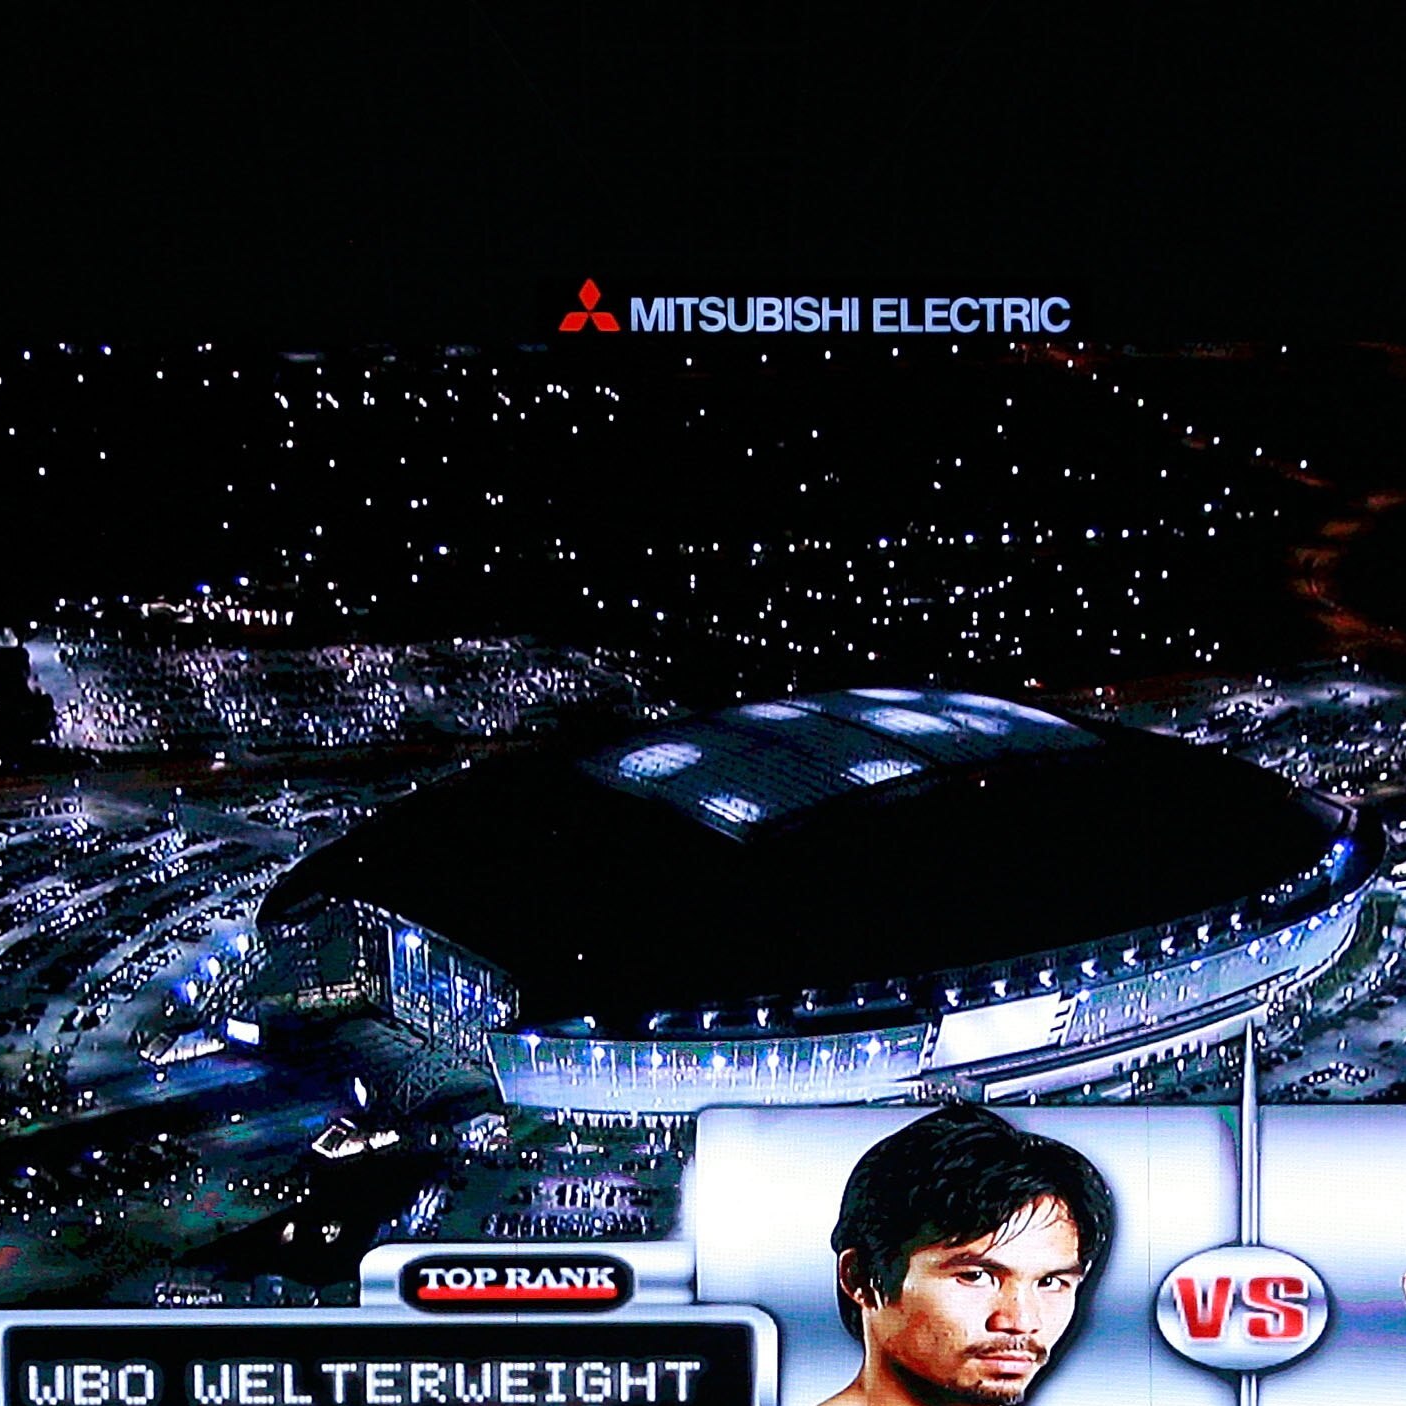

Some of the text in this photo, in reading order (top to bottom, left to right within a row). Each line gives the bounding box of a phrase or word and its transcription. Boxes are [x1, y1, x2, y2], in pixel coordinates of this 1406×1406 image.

[629, 296, 1072, 333] MITSUBISHI ELECTRIC
[420, 1267, 615, 1290] TOP RANK
[1173, 1275, 1308, 1342] VS
[28, 1361, 701, 1406] WBO WELTERWEIGHT
